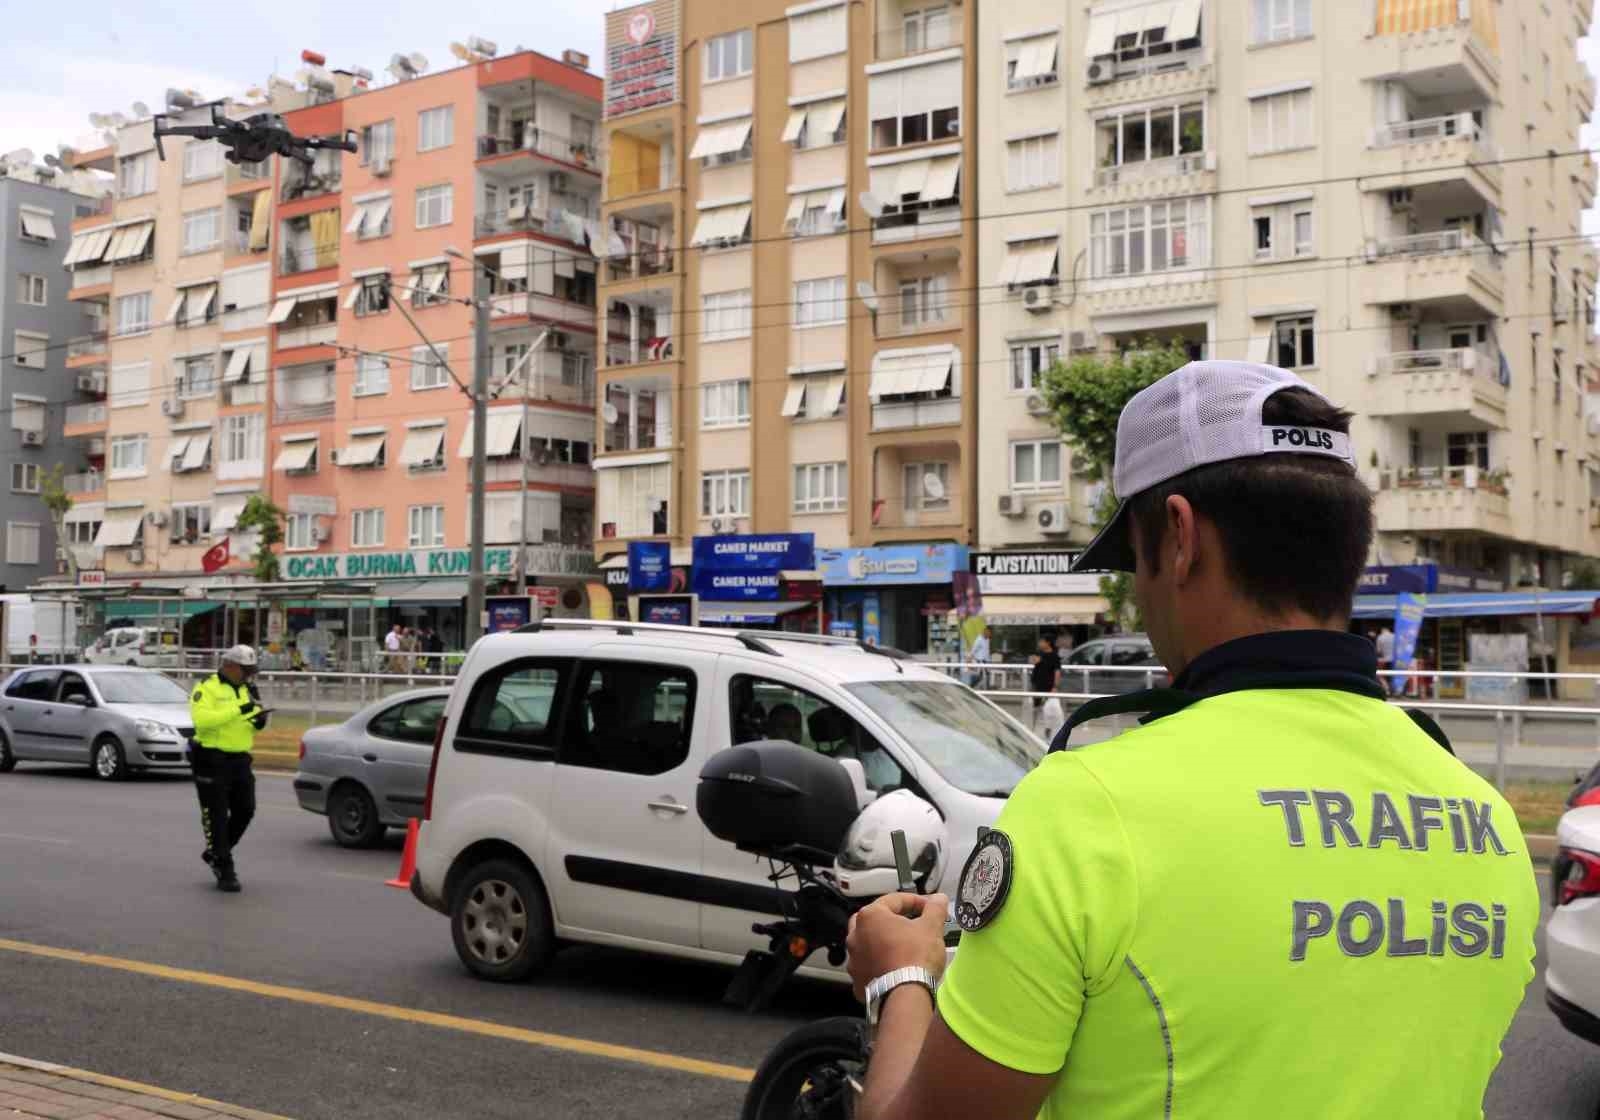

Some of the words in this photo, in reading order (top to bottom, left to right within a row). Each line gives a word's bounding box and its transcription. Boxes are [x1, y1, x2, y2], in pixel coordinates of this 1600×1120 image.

[713, 542, 748, 554] CANER
[749, 540, 790, 553] MARKET
[287, 556, 338, 578] OCAK
[346, 553, 416, 577] BURMA
[427, 550, 512, 574] KUNFE
[976, 554, 1069, 573] PLAYSTATION
[712, 576, 746, 587] CANER
